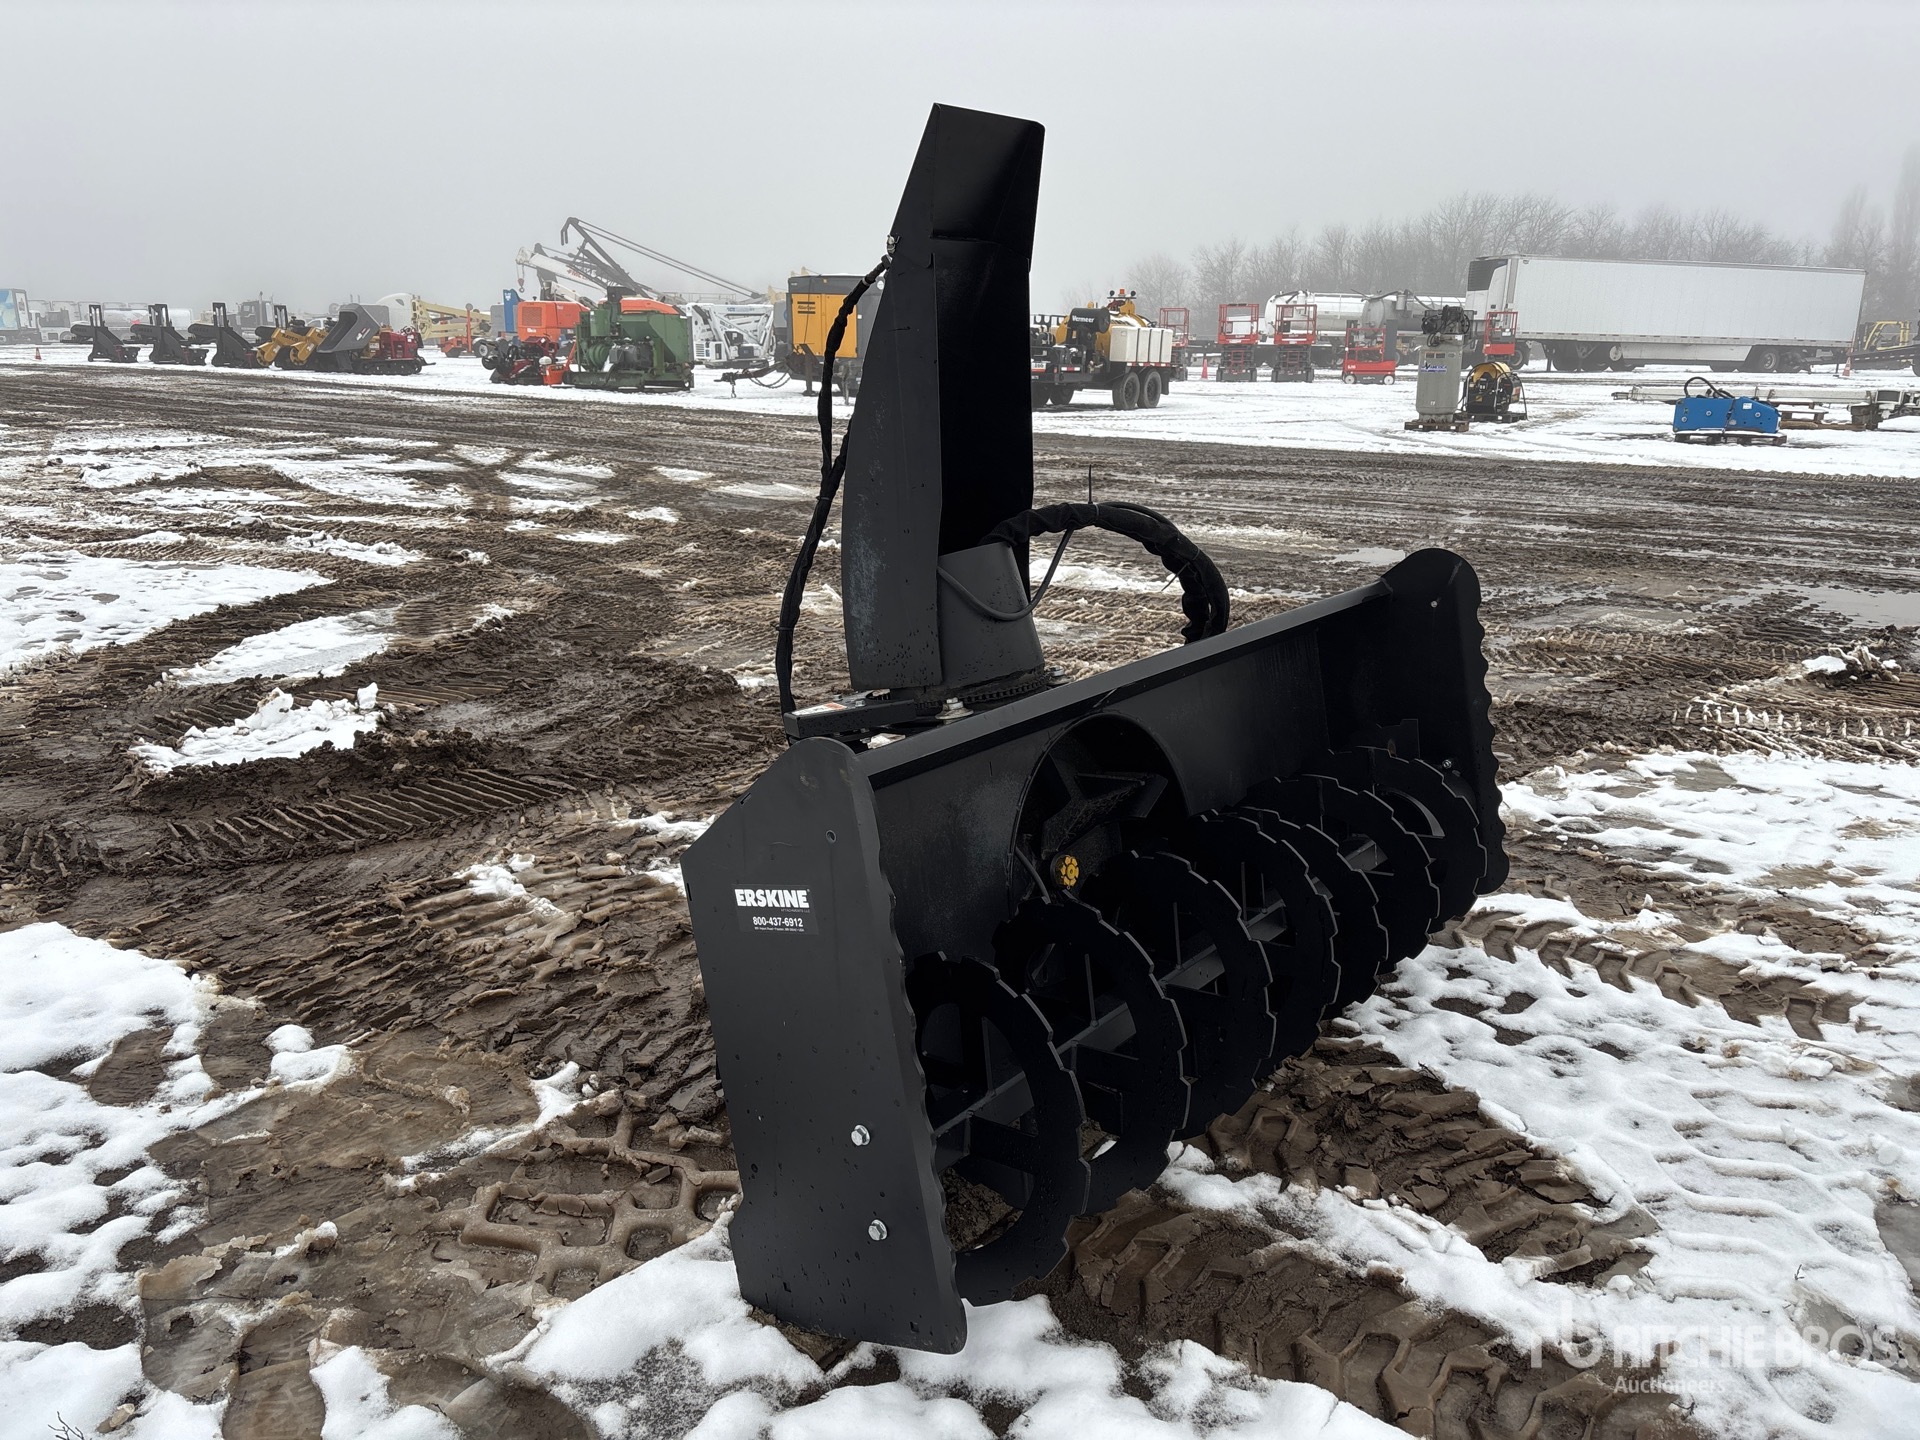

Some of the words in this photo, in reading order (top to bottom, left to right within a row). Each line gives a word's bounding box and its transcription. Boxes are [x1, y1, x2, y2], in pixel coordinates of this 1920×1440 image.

[1072, 314, 1095, 323] Vermeer
[734, 888, 810, 908] ERSKINE
[752, 916, 804, 928] 800-437-6912
